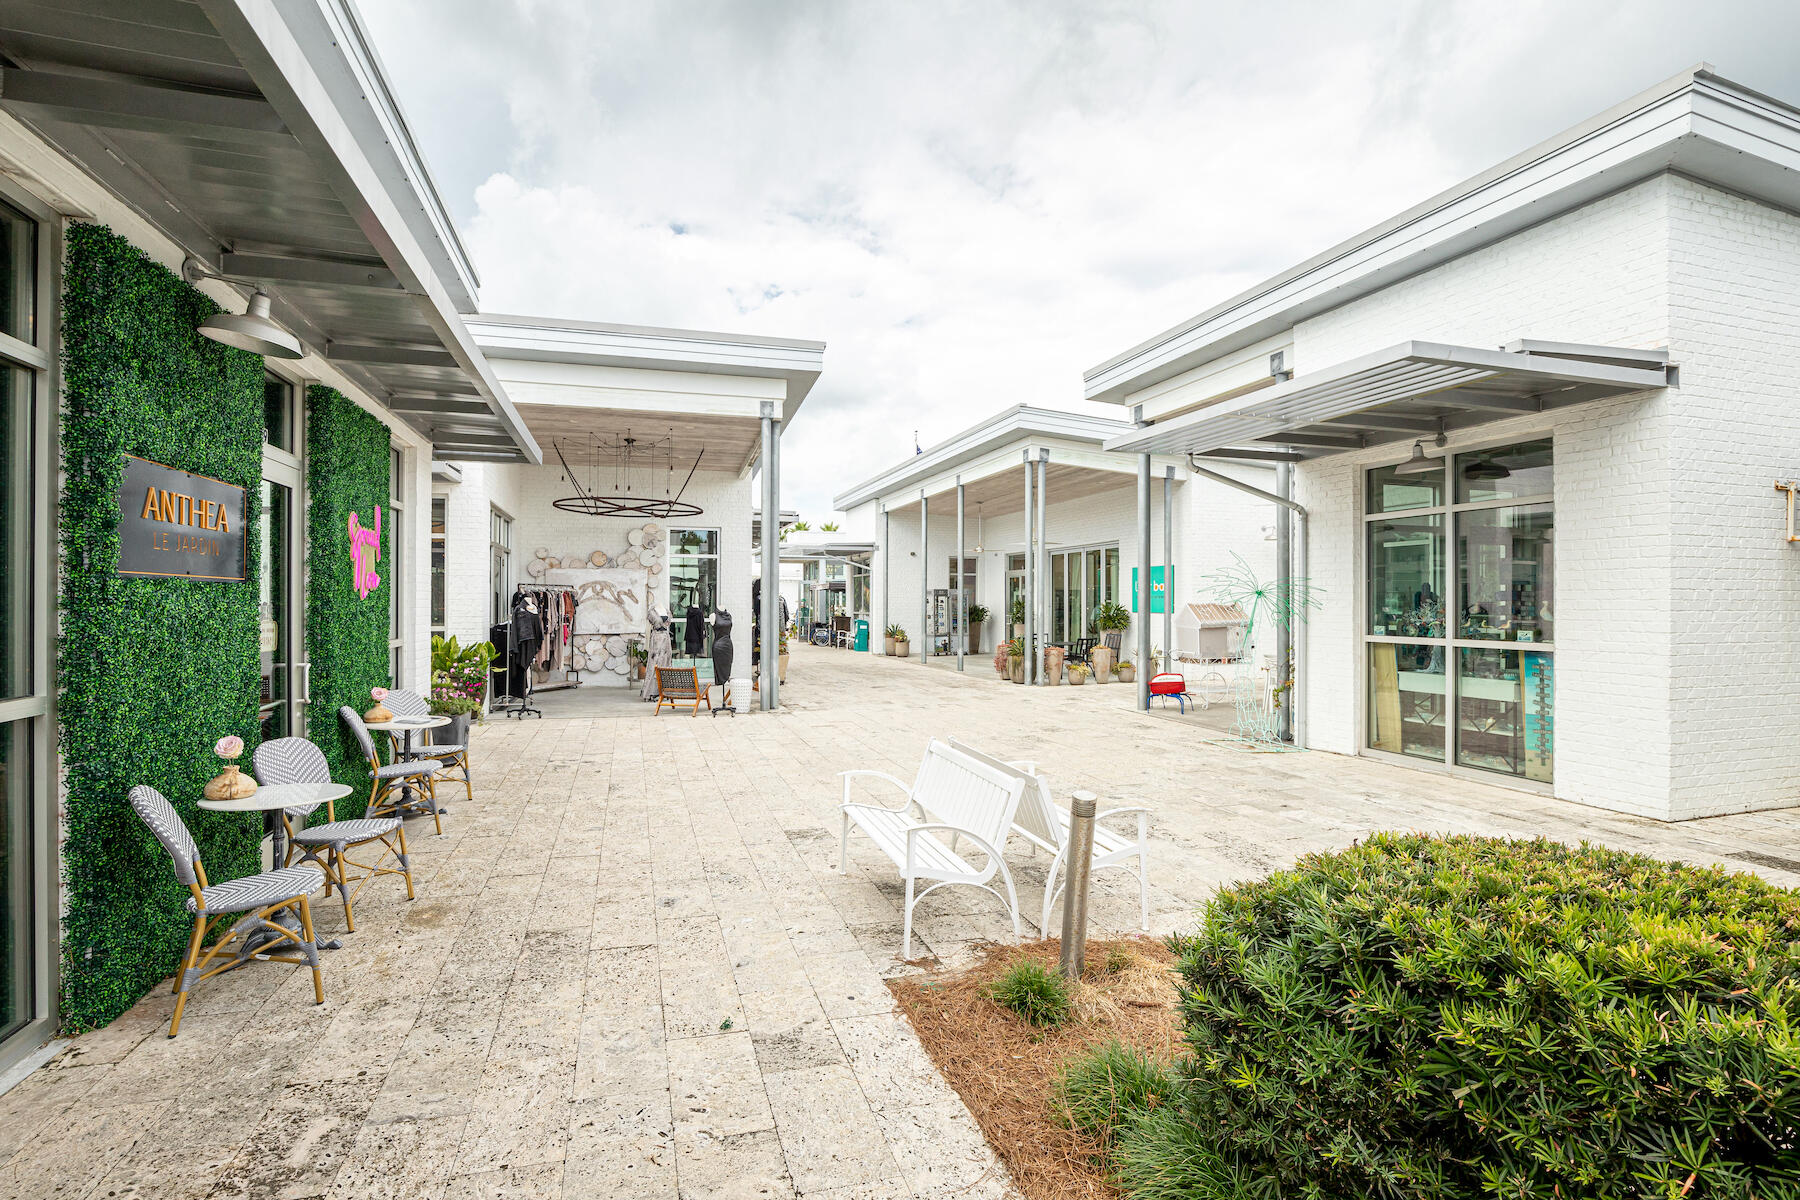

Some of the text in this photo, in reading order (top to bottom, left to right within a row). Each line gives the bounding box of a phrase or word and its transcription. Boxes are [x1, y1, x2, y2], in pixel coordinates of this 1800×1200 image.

[142, 486, 229, 533] ANTHEA
[153, 531, 219, 556] LE JARDIN
